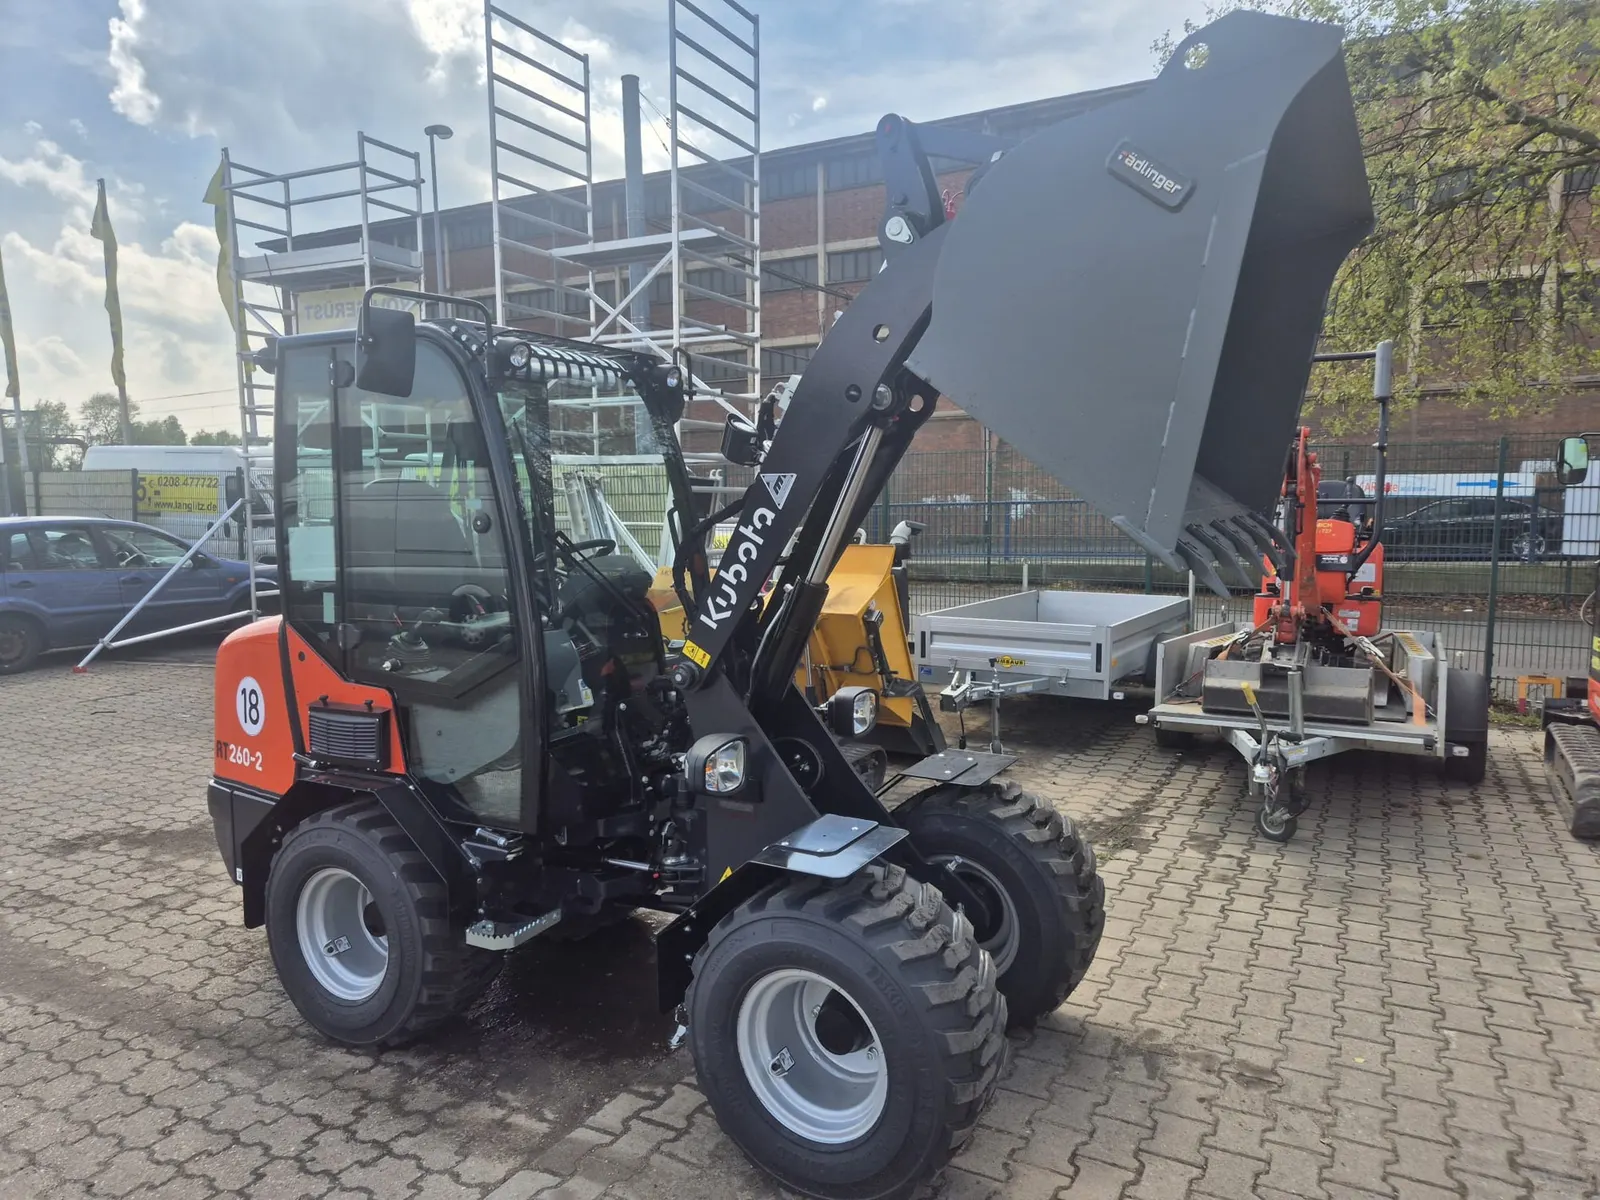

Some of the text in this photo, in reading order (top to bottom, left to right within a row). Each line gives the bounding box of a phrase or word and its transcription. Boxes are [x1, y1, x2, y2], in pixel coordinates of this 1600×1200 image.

[1117, 150, 1183, 194] rädlinger
[157, 476, 180, 487] 0208
[182, 477, 219, 489] 477722
[153, 500, 217, 512] www.langlitz.de
[699, 506, 776, 630] Kubota
[994, 657, 1025, 667] UMBAUR
[240, 687, 260, 726] 18
